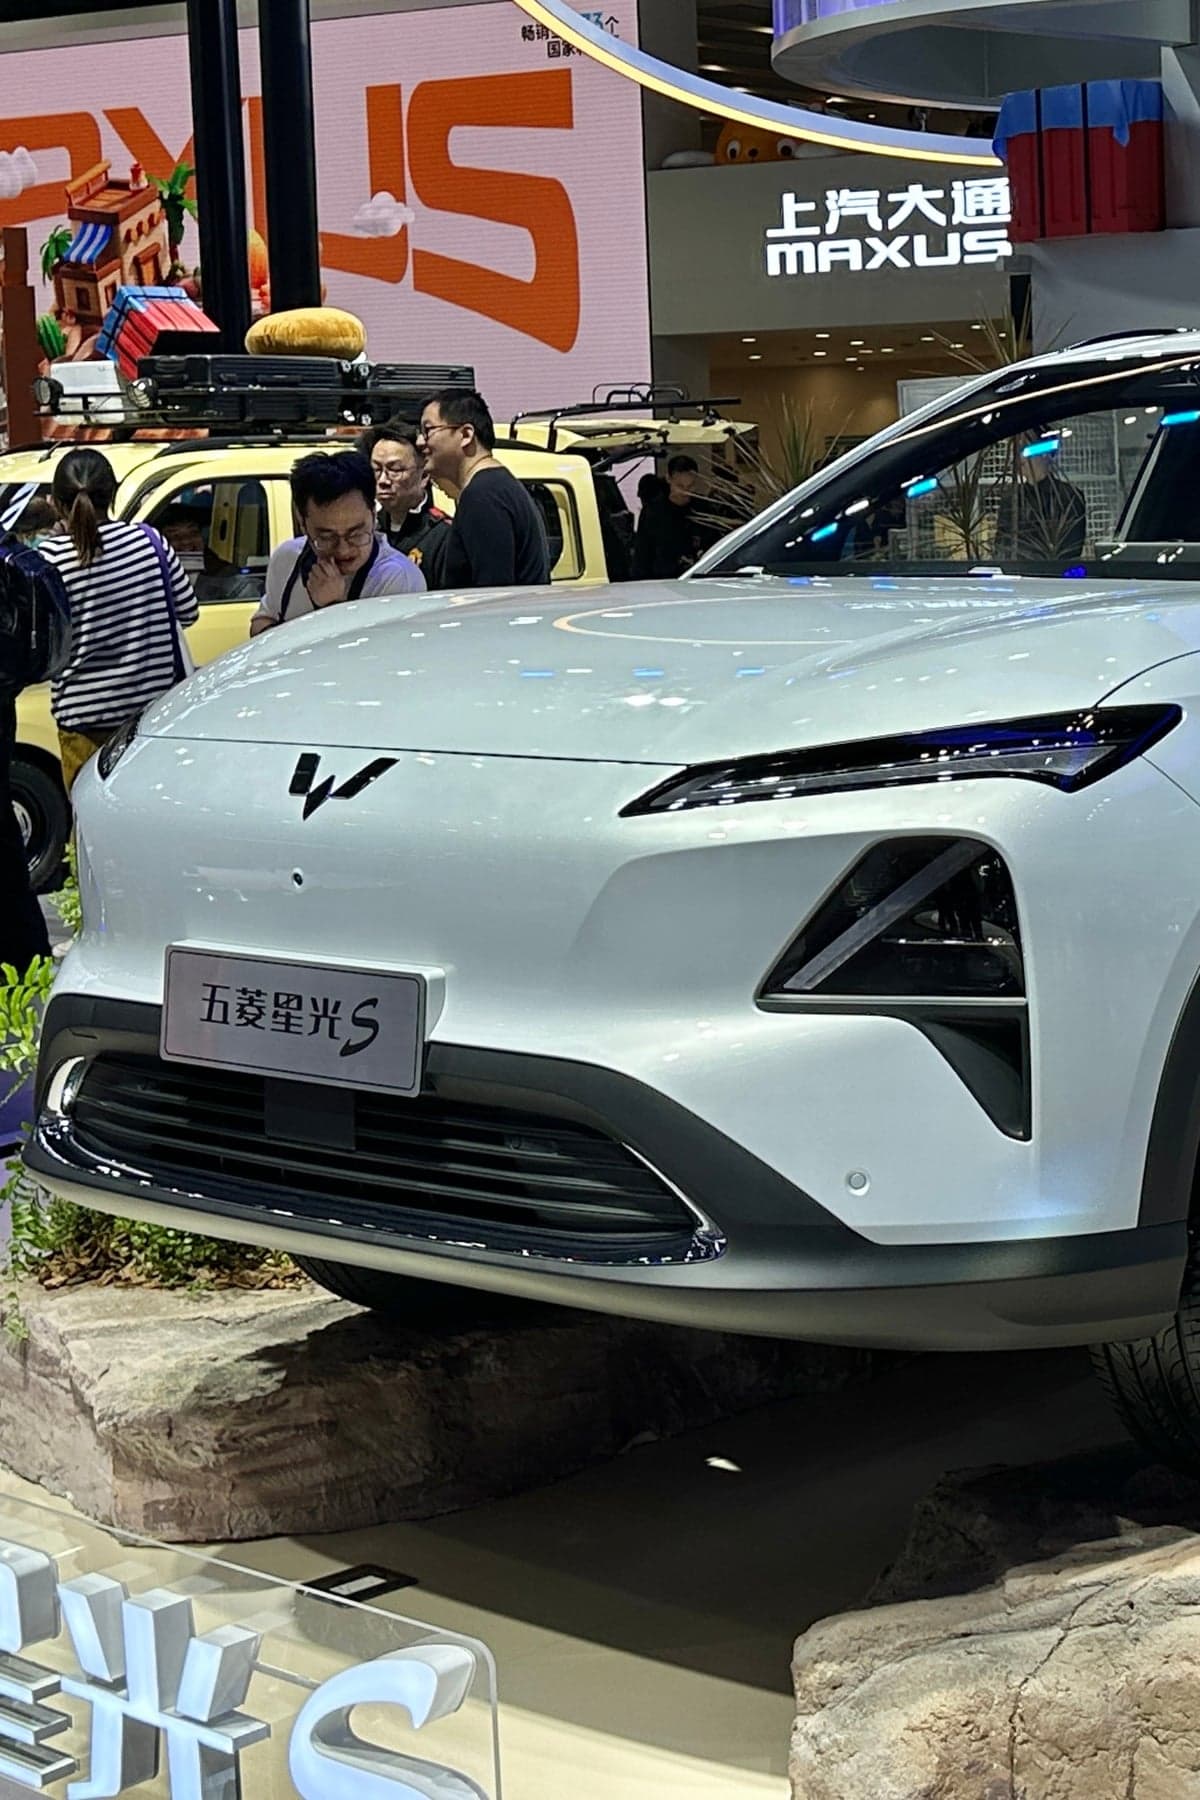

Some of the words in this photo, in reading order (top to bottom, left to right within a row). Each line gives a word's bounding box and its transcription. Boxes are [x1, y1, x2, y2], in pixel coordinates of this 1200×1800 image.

[766, 177, 1012, 238] 上汽大通
[766, 229, 1013, 276] MAXUS
[200, 982, 380, 1057] 五菱星光S
